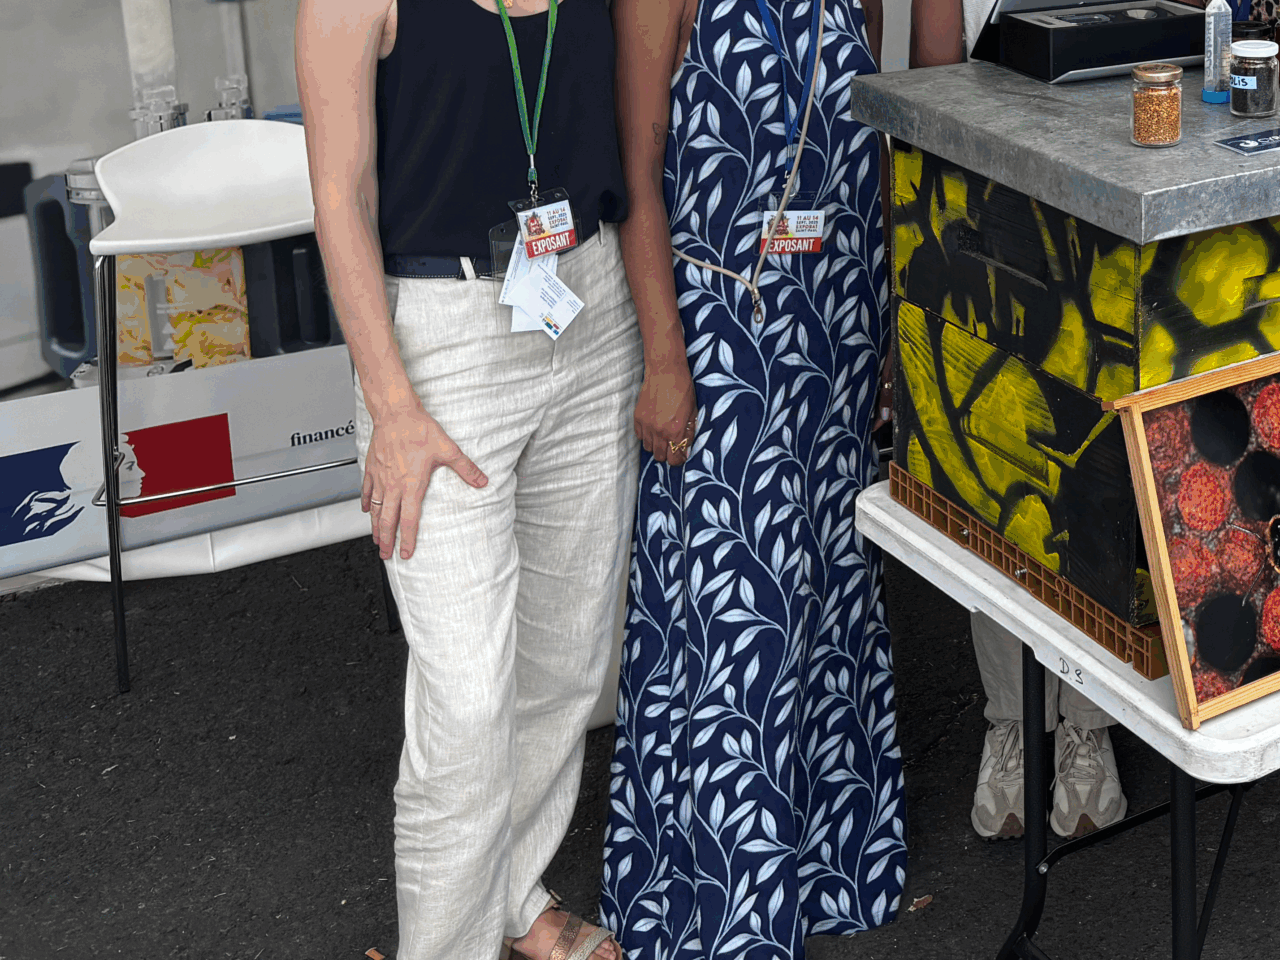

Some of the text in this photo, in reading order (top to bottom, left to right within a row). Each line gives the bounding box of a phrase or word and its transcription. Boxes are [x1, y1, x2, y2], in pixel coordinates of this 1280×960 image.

[531, 231, 571, 256] EXPOSANT
[768, 238, 815, 252] EXPOSANT
[290, 419, 355, 448] financé
